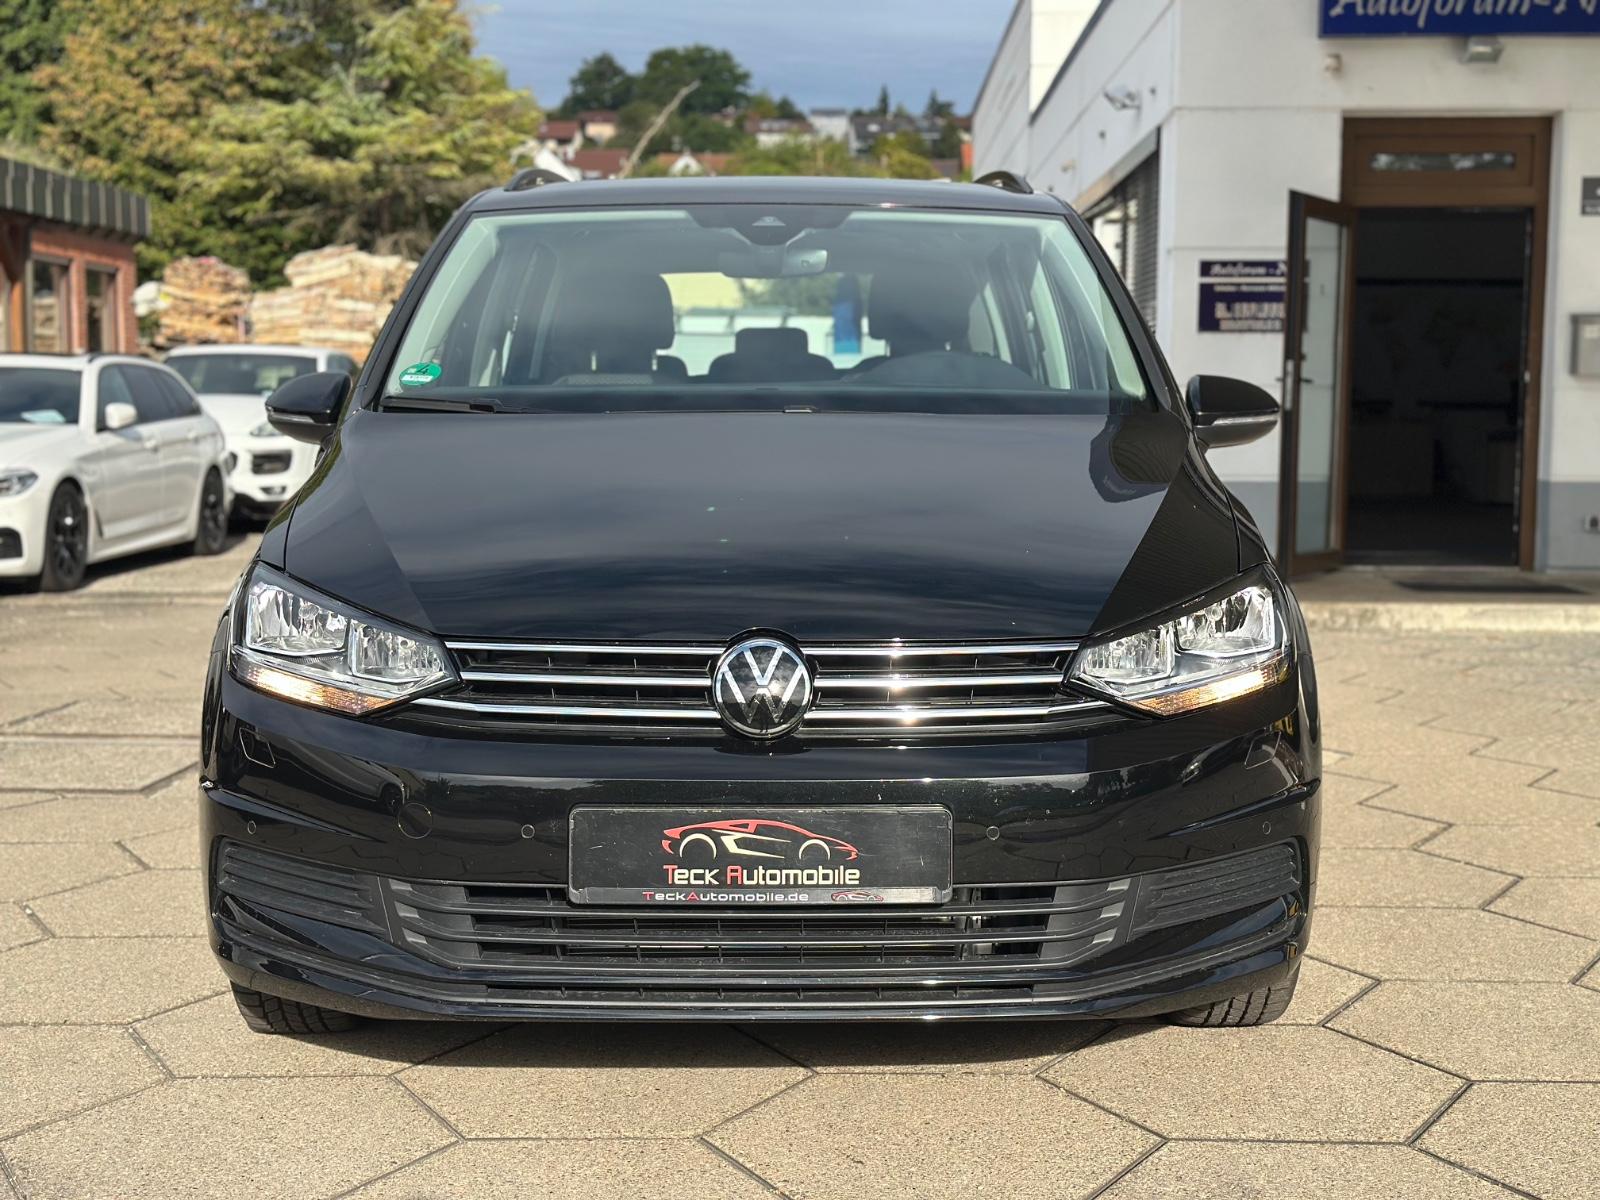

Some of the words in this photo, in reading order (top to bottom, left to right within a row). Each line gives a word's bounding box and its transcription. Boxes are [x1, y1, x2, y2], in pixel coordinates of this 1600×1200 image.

[662, 865, 720, 885] Teck
[726, 865, 861, 886] Automobile
[642, 891, 809, 903] TeckAutomobile.de
